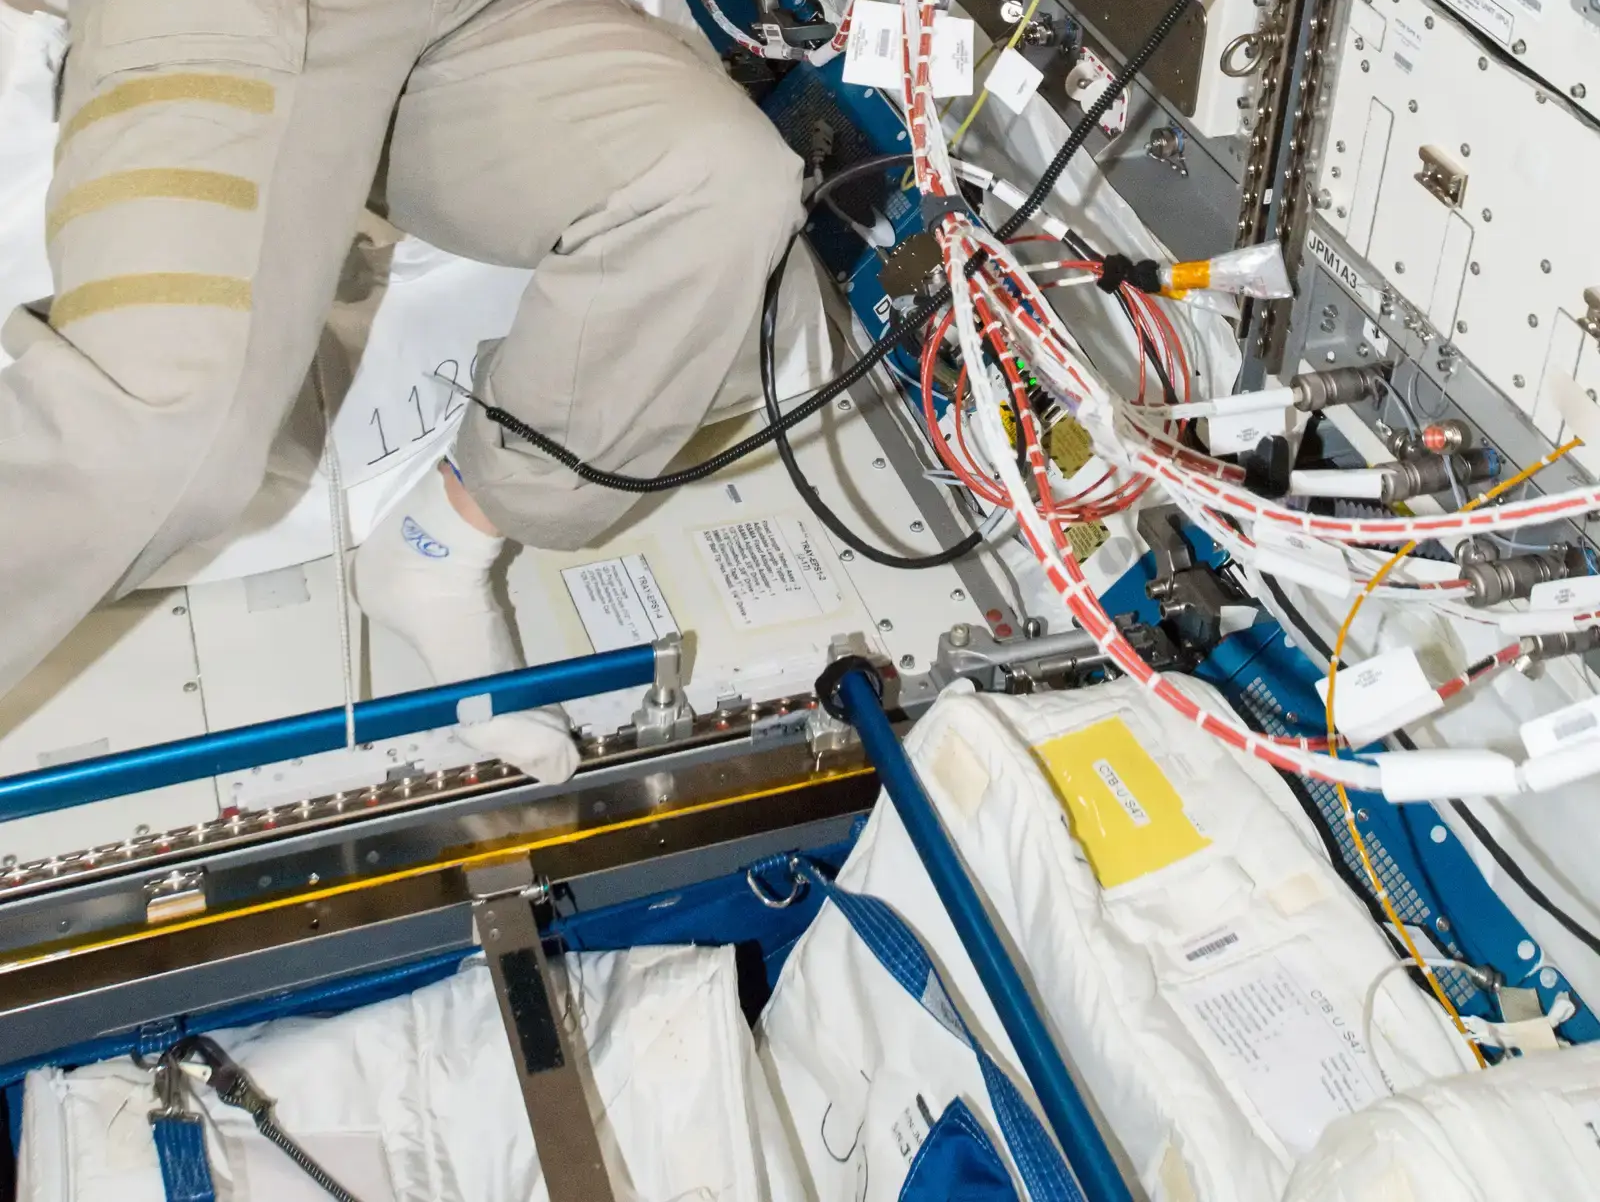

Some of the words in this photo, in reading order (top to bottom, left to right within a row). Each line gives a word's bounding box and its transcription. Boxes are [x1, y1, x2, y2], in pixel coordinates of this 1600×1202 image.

[1308, 232, 1359, 291] JPM1A3
[801, 540, 827, 581] TRAY-EPS1-2
[637, 576, 663, 618] TRAY-EPS1-4
[1311, 990, 1334, 1014] CTB
[1343, 1031, 1367, 1054] S47
